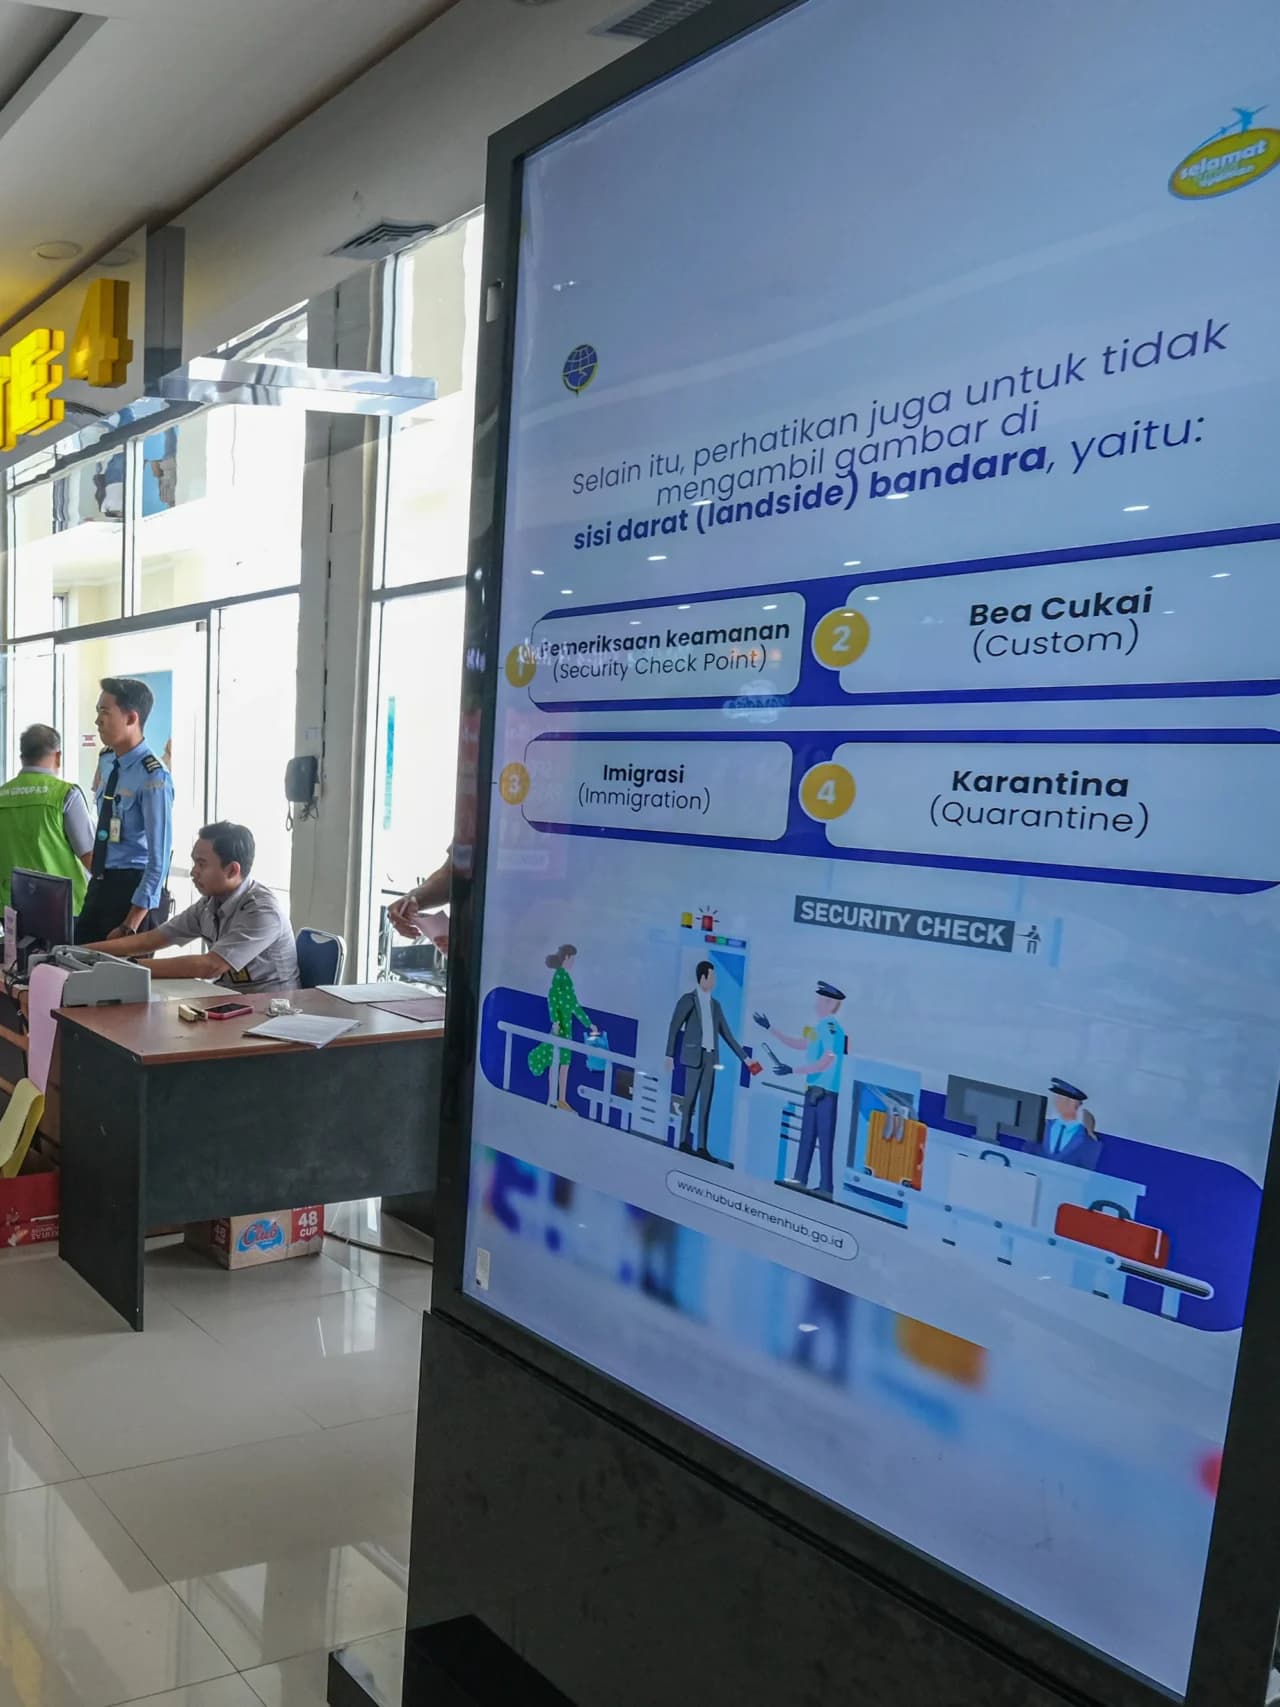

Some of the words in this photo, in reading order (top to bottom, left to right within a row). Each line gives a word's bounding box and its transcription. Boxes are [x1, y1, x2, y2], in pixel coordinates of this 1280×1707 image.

[1181, 139, 1269, 179] selamat
[70, 278, 133, 388] 4
[572, 462, 642, 495] Selain
[648, 452, 685, 477] itu,
[693, 413, 858, 475] perhatikan
[866, 389, 952, 438] juga
[966, 352, 1087, 406] untuk
[1102, 318, 1231, 375] tidak
[657, 448, 825, 506] mengambil
[834, 418, 989, 478] gambar
[1001, 401, 1040, 436] di
[574, 521, 612, 550] sisi
[617, 510, 689, 542] darat
[696, 470, 859, 535] (landside)
[869, 446, 1056, 499] bandara,
[1070, 416, 1206, 475] yaitu:
[970, 602, 1032, 627] Bea
[1041, 585, 1154, 620] Cukai
[666, 623, 790, 648] keamanan
[831, 625, 852, 652] 2
[973, 618, 1139, 664] (Custom)
[553, 661, 628, 682] (Security
[634, 654, 697, 675] Check
[703, 644, 767, 673] Point)
[509, 774, 521, 794] 3
[603, 763, 685, 788] Imigrasi
[816, 779, 836, 806] 4
[952, 770, 1129, 797] Karantina
[578, 781, 711, 815] (Immigration)
[930, 794, 1150, 839] (Quarantine)
[800, 901, 911, 933] SECURITY
[916, 915, 1006, 947] CHECK
[298, 1211, 318, 1228] 48
[300, 1226, 318, 1238] CUP
[677, 1180, 844, 1249] www.hubud.kemenhub.go.id
